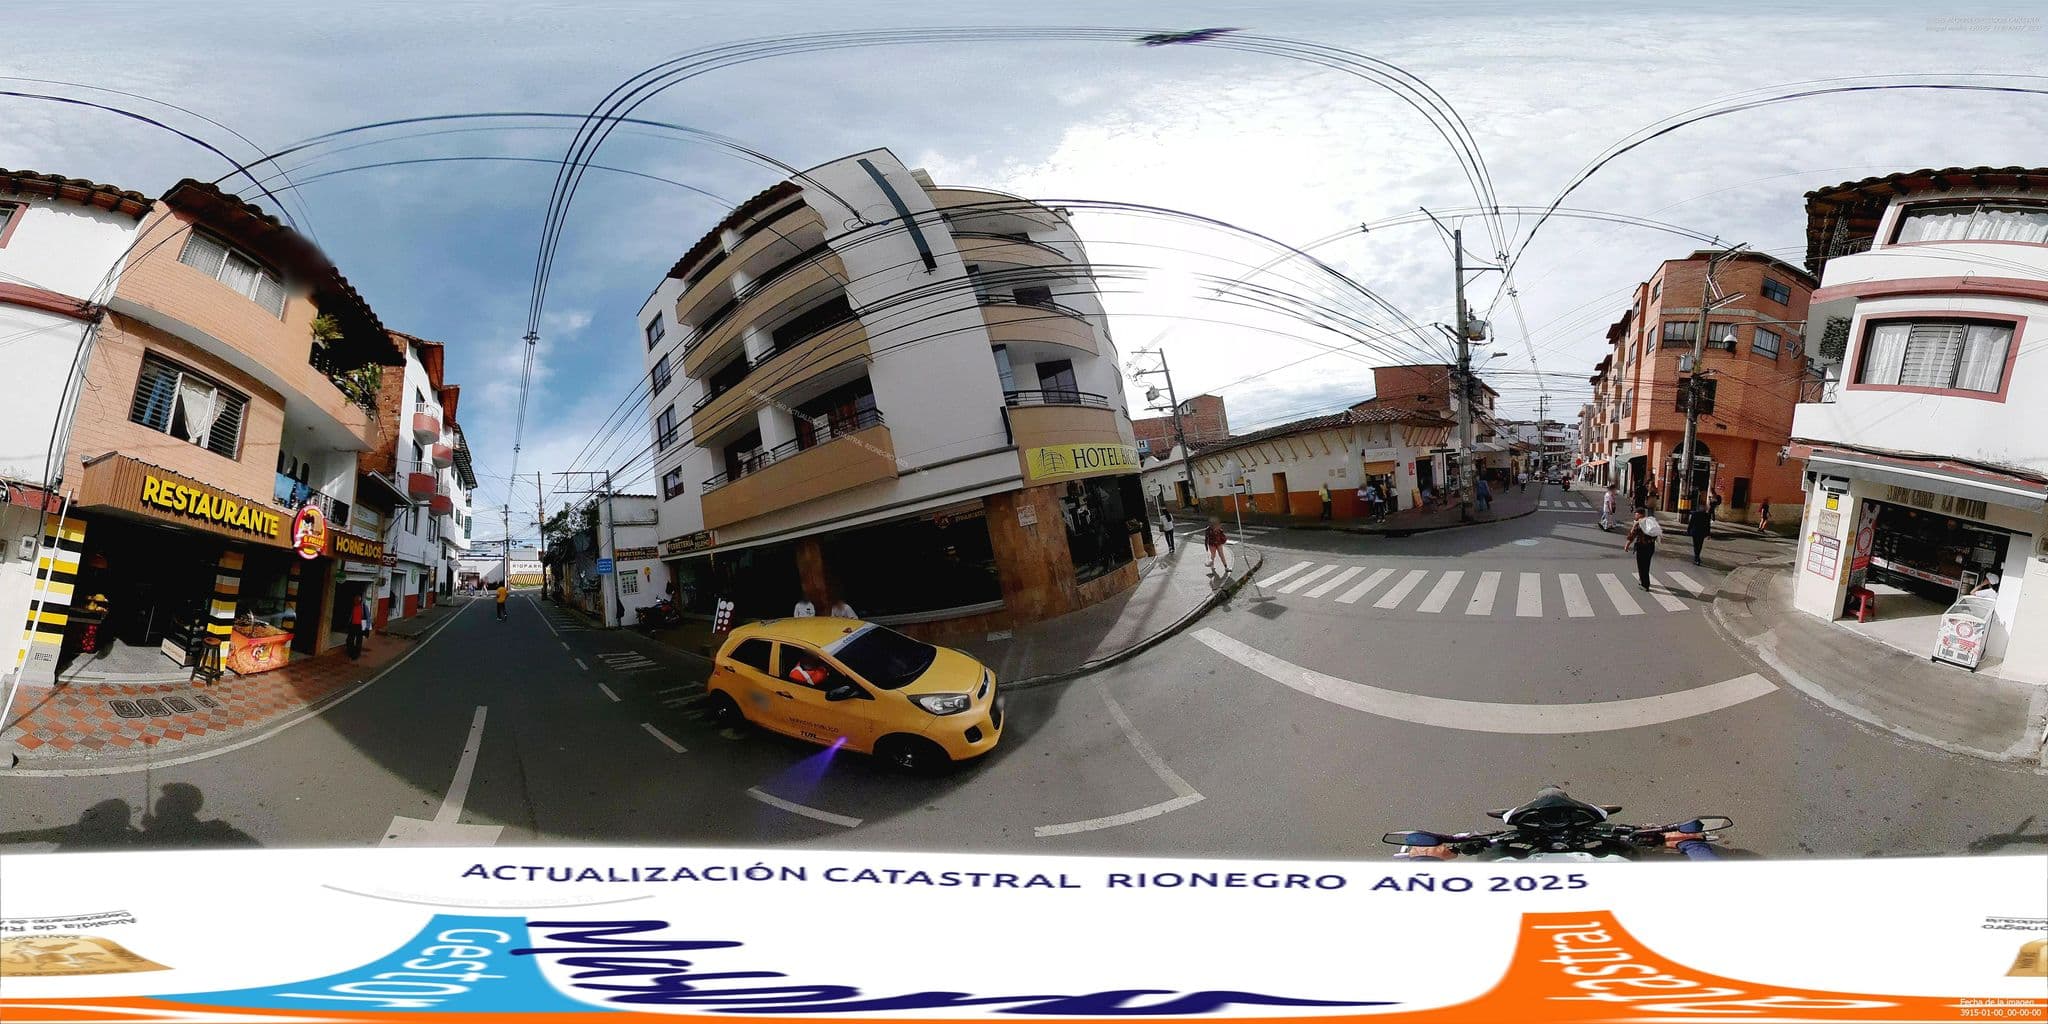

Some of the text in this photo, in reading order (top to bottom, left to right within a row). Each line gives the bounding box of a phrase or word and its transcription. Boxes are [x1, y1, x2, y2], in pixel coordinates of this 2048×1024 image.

[1072, 447, 1120, 469] HOTEL
[142, 475, 280, 536] RESTAURANTE
[336, 535, 382, 560] HORNEADOS
